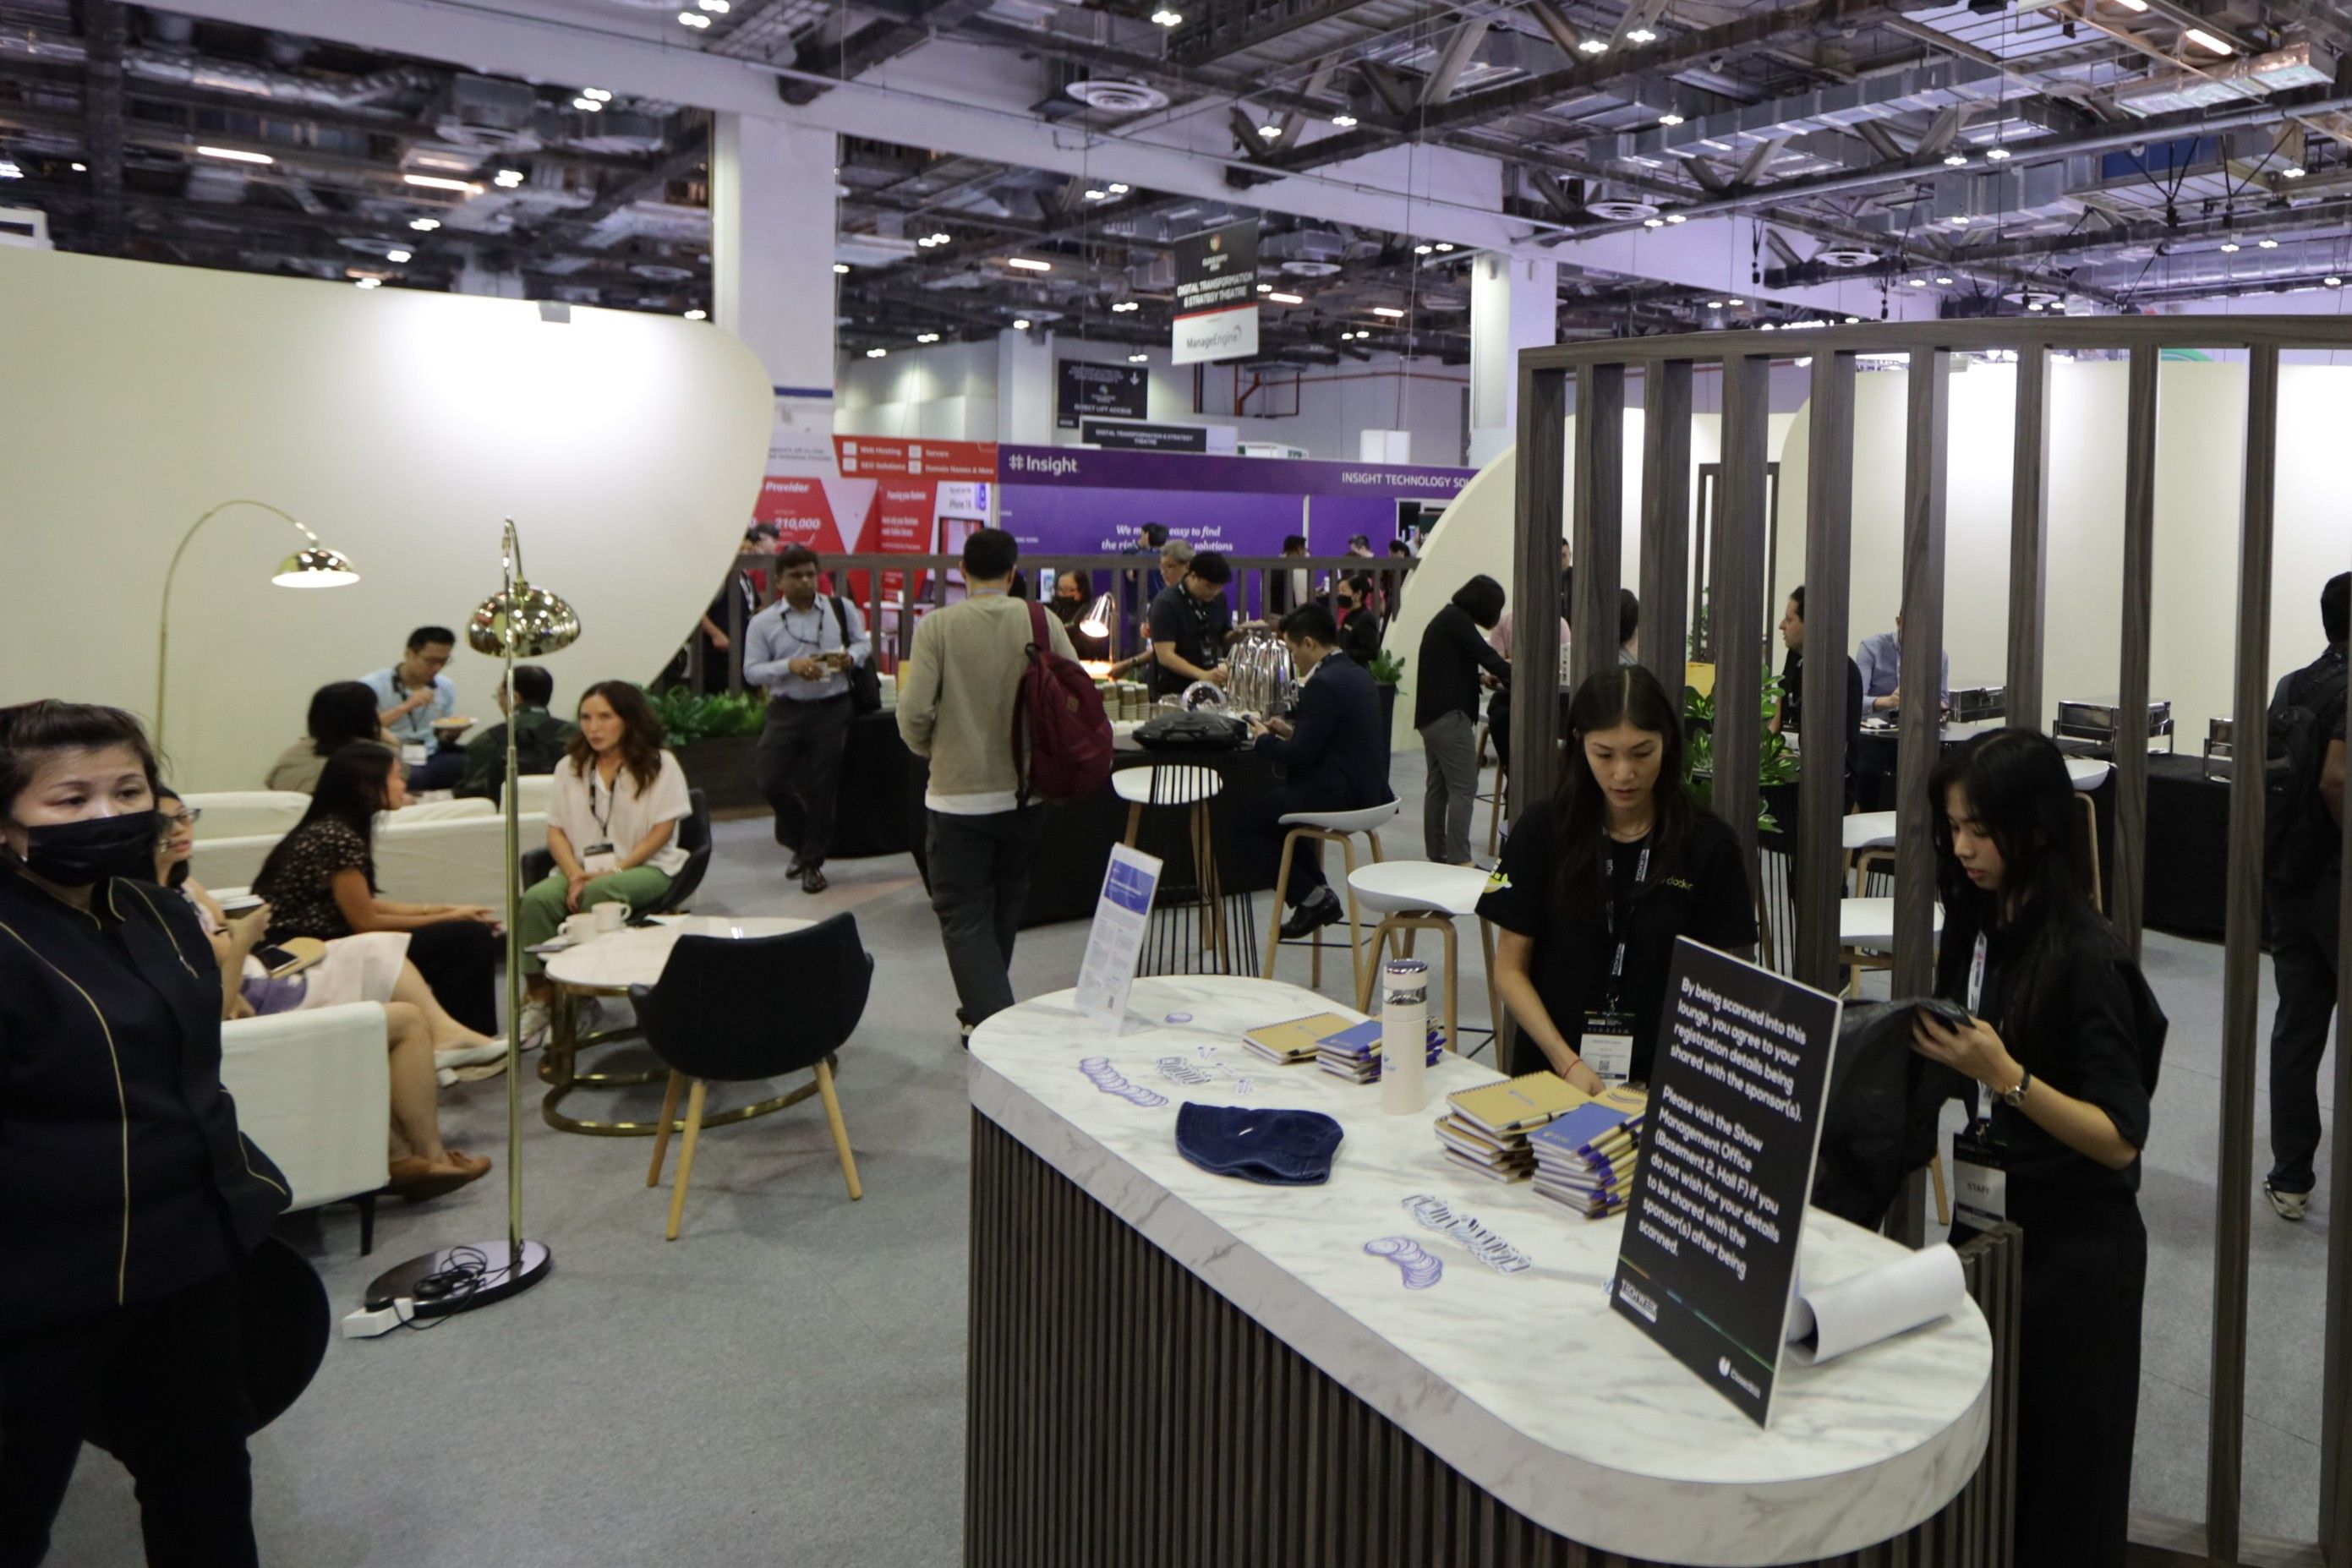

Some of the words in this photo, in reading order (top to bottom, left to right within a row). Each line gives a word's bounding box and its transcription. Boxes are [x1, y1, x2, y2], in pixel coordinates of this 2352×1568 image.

[1177, 282, 1199, 297] DIGITAL
[1200, 271, 1254, 291] TRANSFORMATION
[1189, 292, 1218, 307] STRATEGY
[1219, 286, 1247, 300] THEATRE
[1186, 331, 1239, 349] ManageEngine
[876, 446, 901, 457] Hosting
[1027, 456, 1078, 477] Insight
[765, 481, 810, 493] Provider
[1342, 472, 1383, 485] INSIGHT
[1385, 473, 1452, 488] TECHNOLOGY
[1101, 538, 1117, 550] the
[1194, 539, 1233, 552] solutions
[1116, 524, 1131, 536] We
[1168, 527, 1190, 538] easy
[1191, 527, 1201, 536] to
[1201, 525, 1222, 539] find
[1677, 998, 1710, 1029] lounge,
[1711, 1016, 1731, 1035] you
[1731, 1027, 1761, 1049] agree
[1762, 1037, 1774, 1056] to
[1775, 1046, 1801, 1067] your
[1682, 976, 1694, 997] By
[1695, 982, 1722, 1012] being
[1722, 997, 1764, 1026] scanned
[1764, 1013, 1786, 1035] into
[1786, 1024, 1807, 1045] this
[1670, 1043, 1704, 1071] shared
[1704, 1061, 1726, 1083] with
[1727, 1071, 1744, 1091] the
[1745, 1081, 1802, 1123] sponsor(s).
[1674, 1023, 1729, 1058] registration
[1729, 1048, 1764, 1076] details
[1764, 1063, 1794, 1096] being
[1659, 1106, 1720, 1155] Management
[1721, 1141, 1753, 1173] Office
[1662, 1084, 1694, 1113] Please
[1695, 1104, 1715, 1126] visit
[1715, 1114, 1733, 1136] the
[1733, 1122, 1764, 1153] Show
[1650, 1151, 1663, 1170] do
[1663, 1164, 1681, 1180] not
[1681, 1170, 1703, 1196] wish
[1704, 1183, 1719, 1204] for
[1720, 1194, 1744, 1220] your
[1743, 1210, 1780, 1244] details
[1655, 1128, 1705, 1172] (Basement
[1705, 1158, 1715, 1179] 2,
[1716, 1165, 1737, 1189] Hall
[1737, 1176, 1749, 1199] F)
[1748, 1183, 1759, 1202] if
[1759, 1192, 1779, 1216] you
[1647, 1172, 1657, 1191] to
[1657, 1178, 1671, 1199] be
[1671, 1188, 1705, 1221] shared
[1705, 1212, 1728, 1237] with
[1729, 1226, 1747, 1249] the
[1638, 1218, 1678, 1257] scanned.
[1643, 1197, 1692, 1239] sponsor(s)
[1692, 1228, 1718, 1255] after
[1718, 1243, 1748, 1281] being
